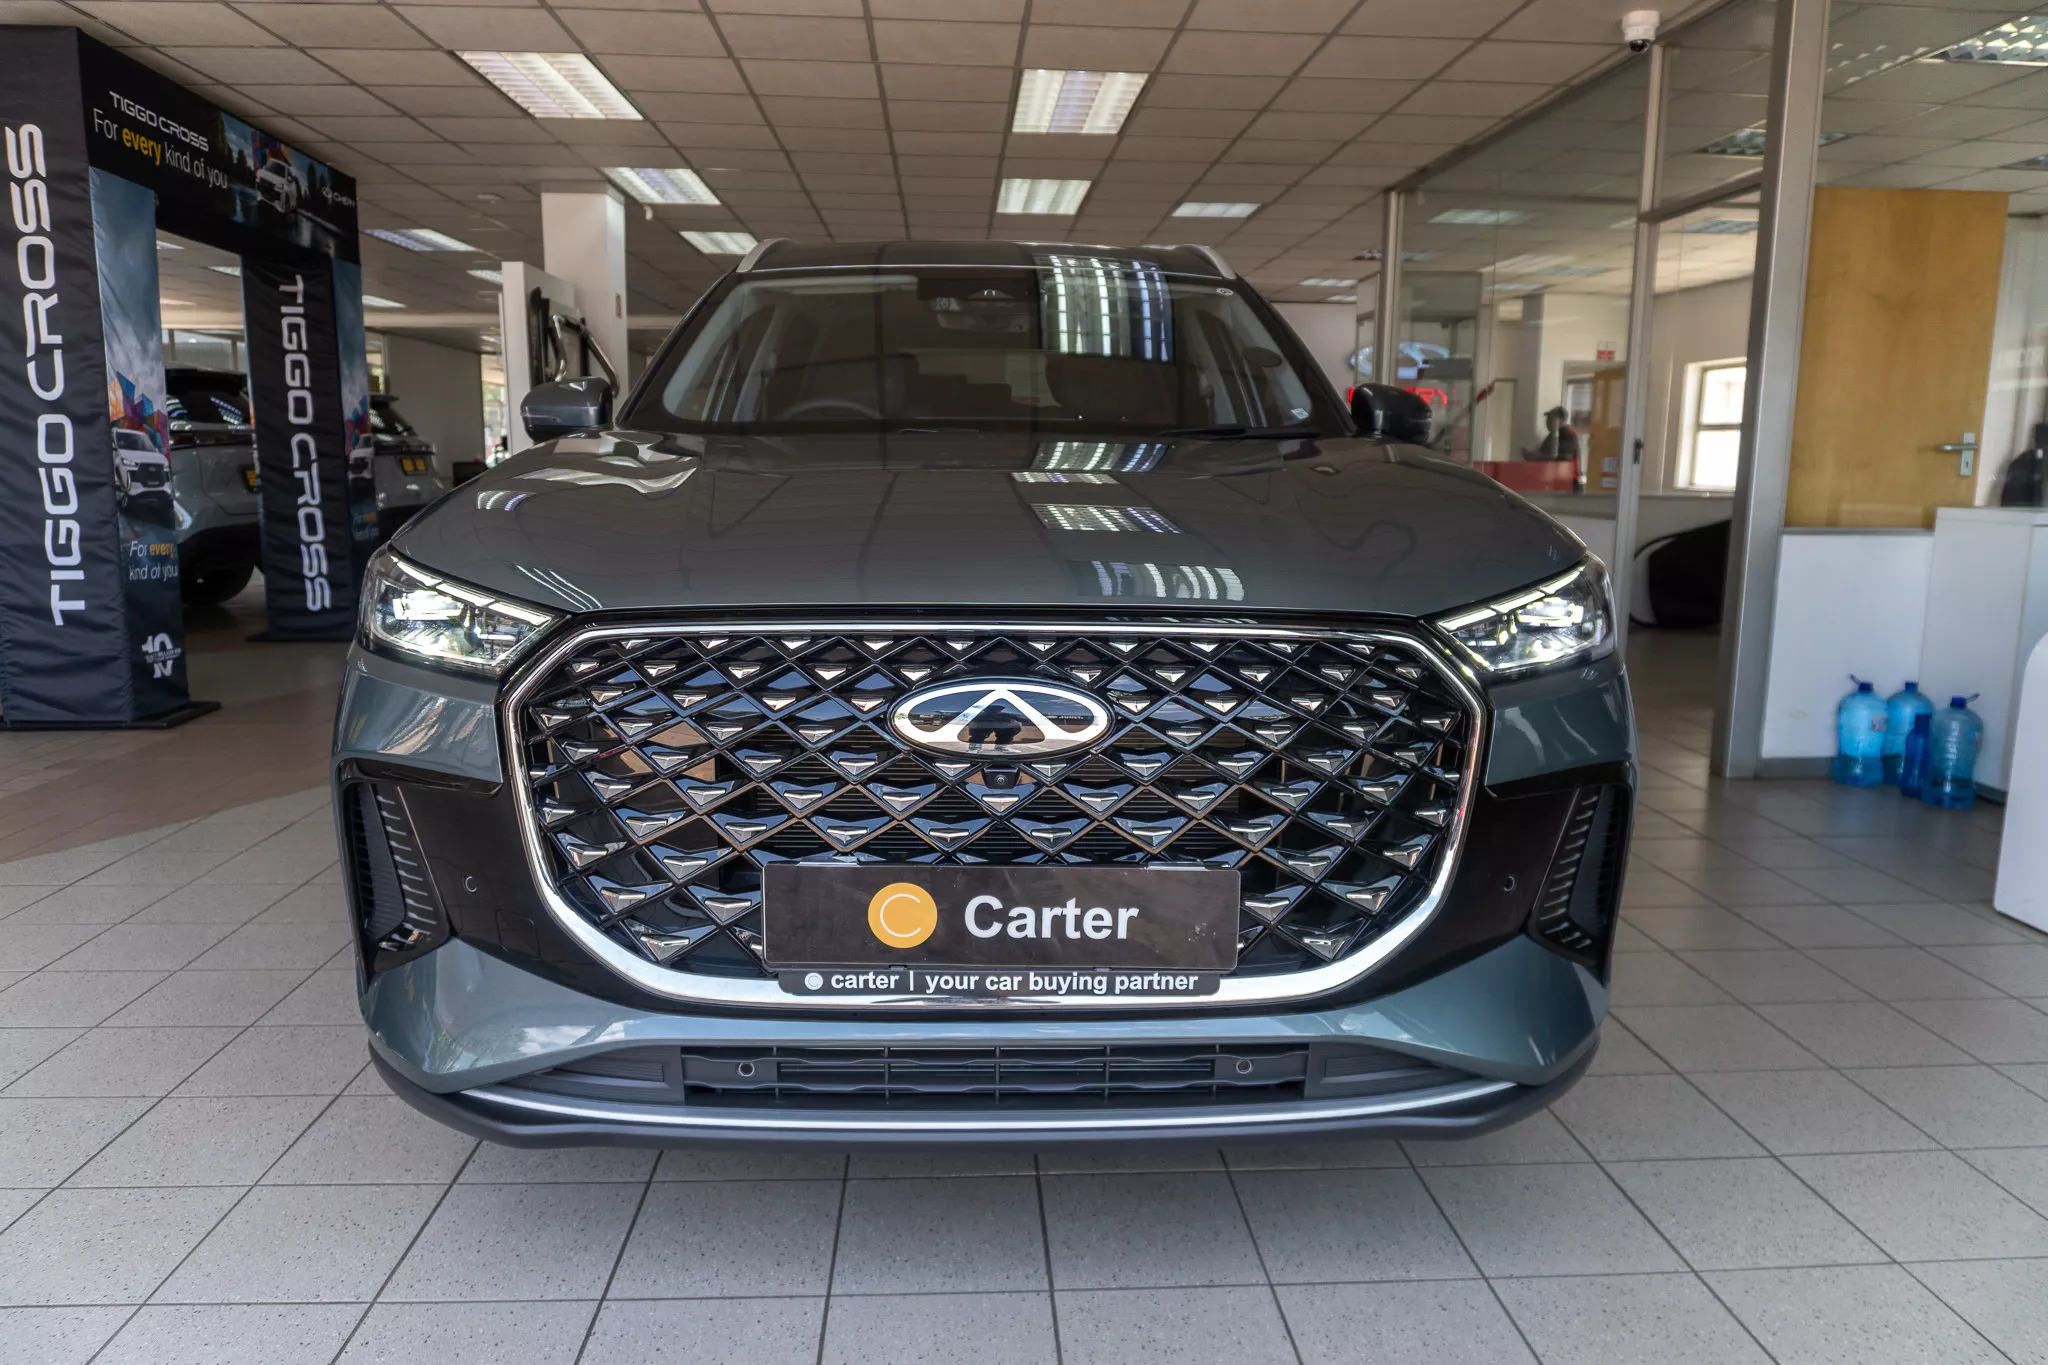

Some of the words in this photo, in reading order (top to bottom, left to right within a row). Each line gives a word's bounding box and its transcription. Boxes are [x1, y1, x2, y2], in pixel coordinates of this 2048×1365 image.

[93, 107, 119, 140] For
[122, 127, 161, 166] every
[164, 141, 190, 173] kind
[193, 157, 205, 179] of
[207, 166, 228, 189] you
[109, 91, 158, 127] TIGGO
[159, 117, 209, 152] CROSS
[4, 123, 65, 401] CROSS
[278, 274, 314, 425] TIGGO
[37, 414, 86, 627] TIGGO
[129, 540, 148, 557] For
[149, 542, 174, 559] every
[290, 431, 332, 612] CROSS
[129, 563, 149, 580] kind
[150, 562, 161, 579] of
[162, 564, 178, 583] you
[964, 894, 1139, 940] Carter
[831, 971, 900, 990] carter
[925, 974, 980, 994] your
[985, 974, 1023, 991] car
[1029, 971, 1108, 995] buying
[1115, 971, 1199, 995] partner
